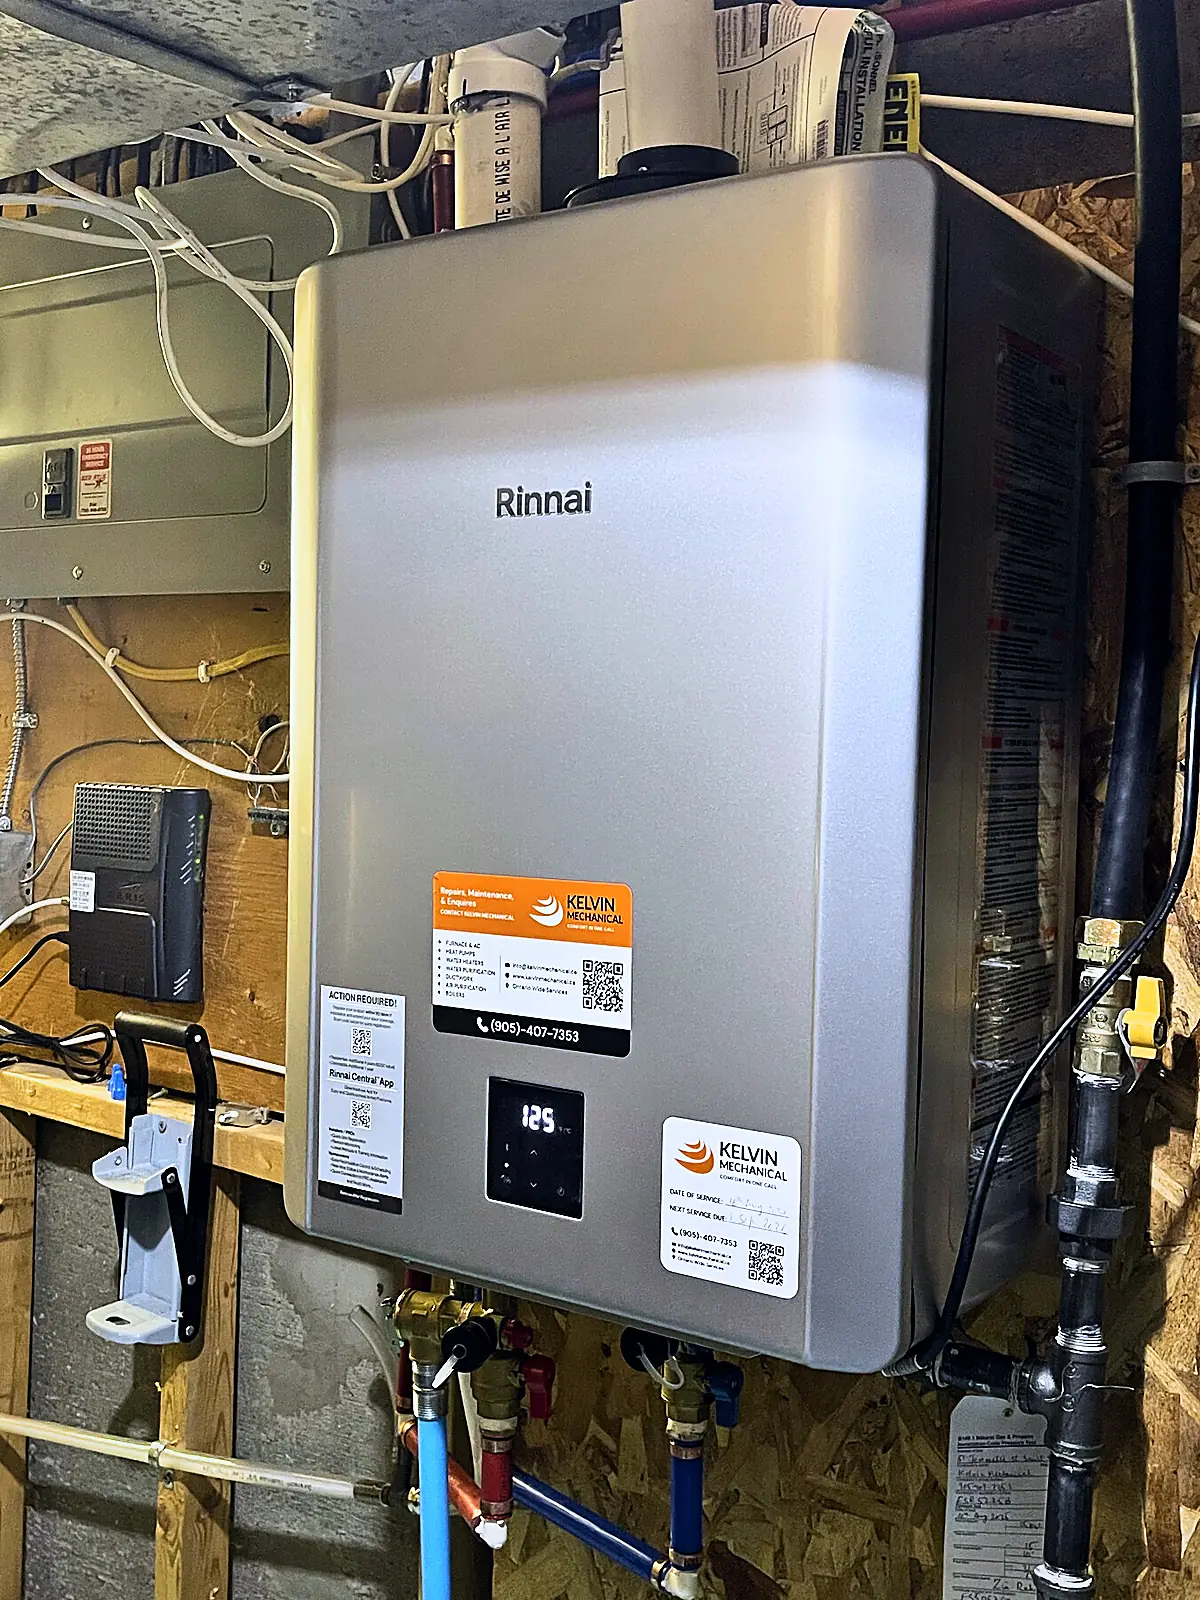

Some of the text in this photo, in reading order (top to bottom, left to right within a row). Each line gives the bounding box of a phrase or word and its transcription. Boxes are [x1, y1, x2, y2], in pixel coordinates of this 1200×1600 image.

[852, 56, 871, 152] INSTALLATION
[495, 147, 511, 155] A
[495, 190, 511, 204] DE
[496, 481, 592, 518] Rinnai
[440, 886, 514, 901] Repairs, Maintenance,
[447, 898, 476, 908] Enquires
[567, 894, 615, 912] KELVIN
[567, 912, 623, 924] MECHANICAL
[329, 991, 397, 1007] ACTION REQUIRED!
[490, 1018, 579, 1042] (905)-407-7353
[329, 1069, 350, 1080] Rinnai
[380, 1077, 394, 1088] App
[522, 1104, 555, 1134] 125
[720, 1141, 778, 1166] KELVIN
[720, 1160, 788, 1182] MECHANICAL
[670, 1188, 723, 1204] DATE OF SERVICE:
[670, 1204, 686, 1213] NEXT
[687, 1208, 712, 1219] SERVICE
[680, 1228, 738, 1248] (905)-407-7353
